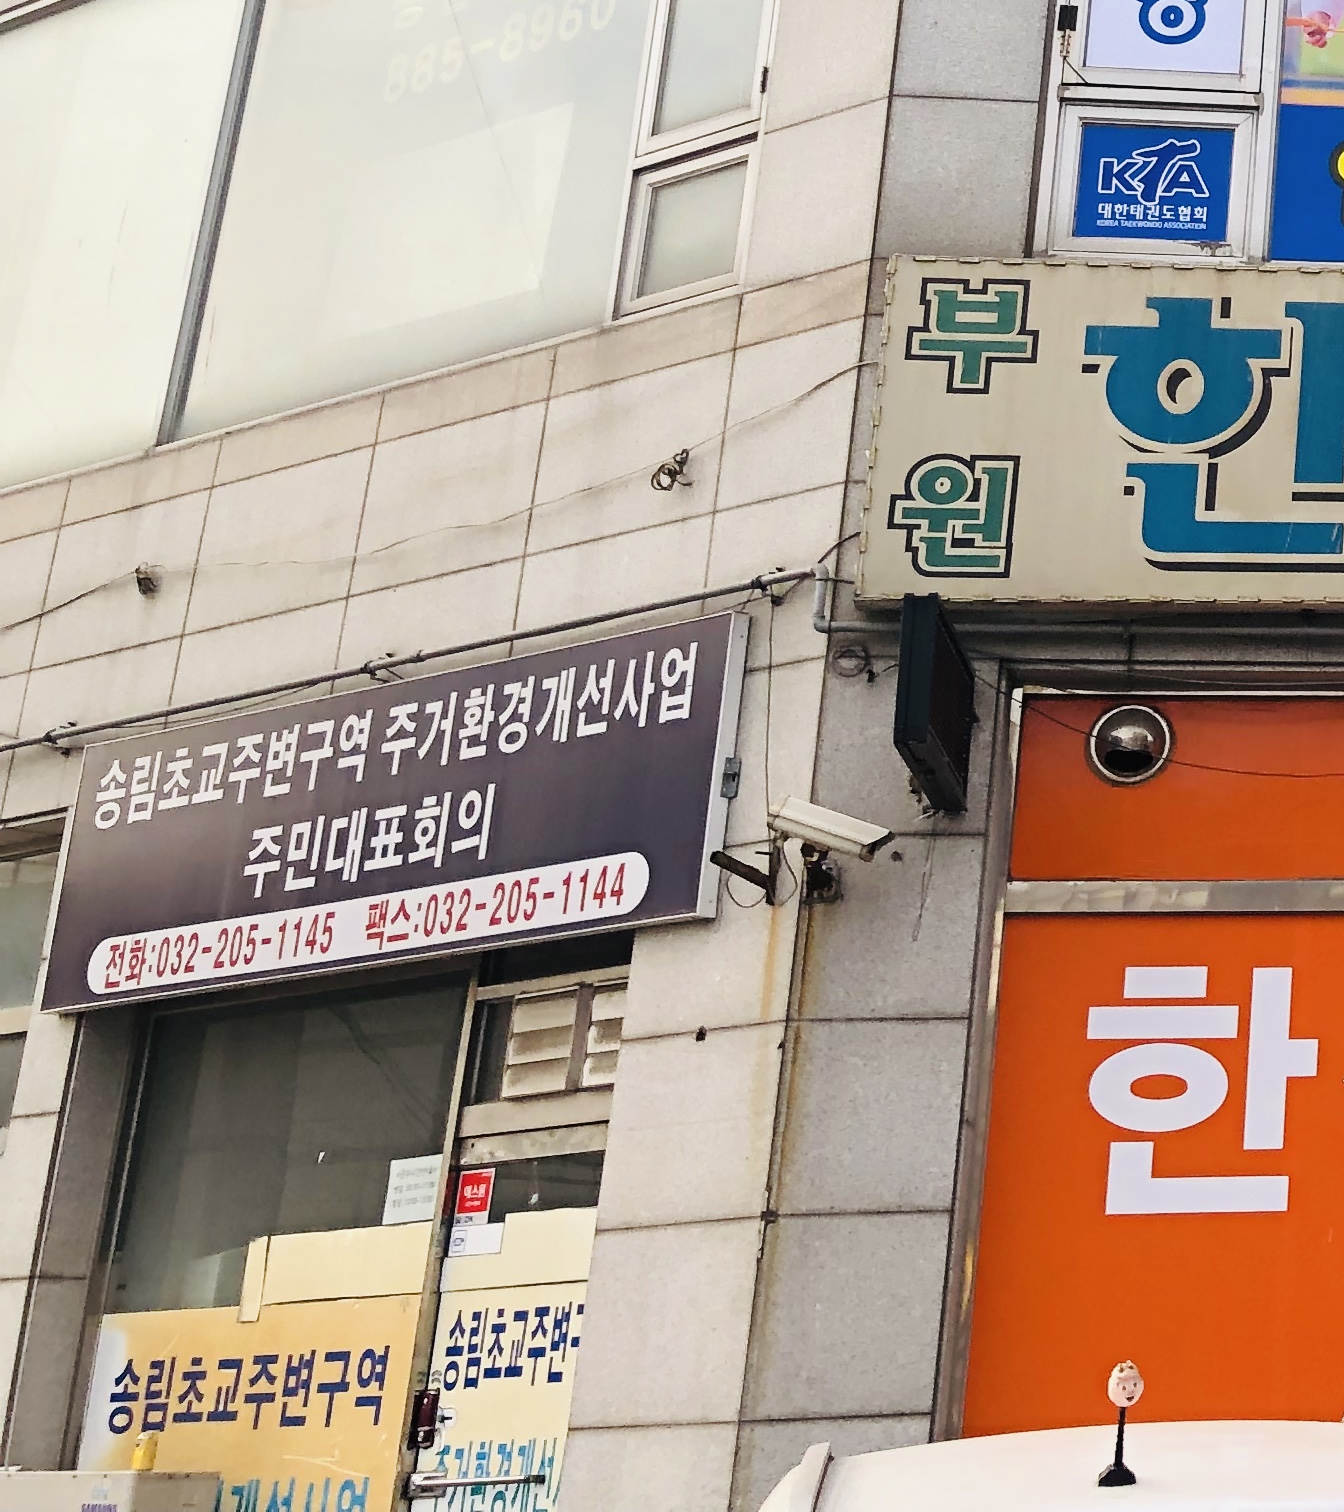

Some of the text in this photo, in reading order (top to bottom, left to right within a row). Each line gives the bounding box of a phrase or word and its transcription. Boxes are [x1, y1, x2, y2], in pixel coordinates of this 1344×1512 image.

[1098, 139, 1209, 205] KTA
[1098, 203, 1208, 222] 대한태권도협회
[94, 641, 699, 831] 송림초교주변구역 주거환경개선사업
[242, 782, 497, 900] 주민대표회의
[107, 1343, 391, 1436] 송림초교주변구역
[443, 1301, 585, 1391] 송림초교주변
